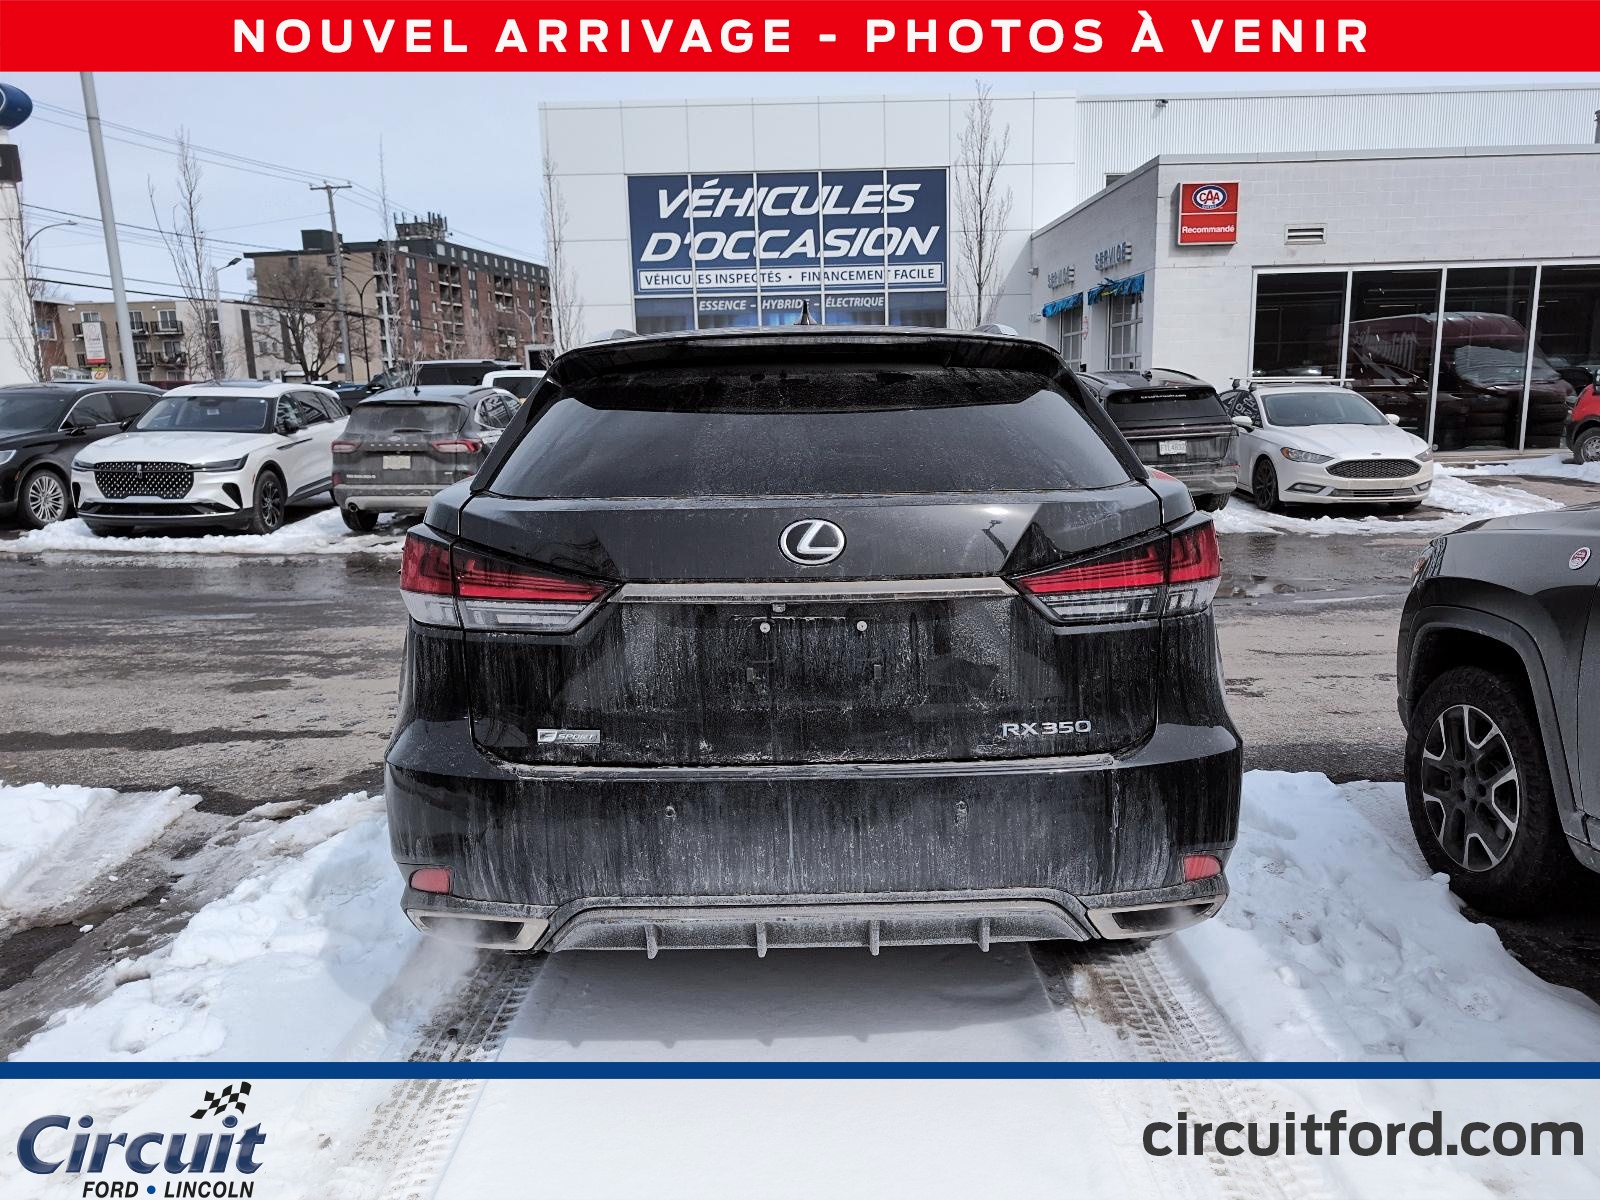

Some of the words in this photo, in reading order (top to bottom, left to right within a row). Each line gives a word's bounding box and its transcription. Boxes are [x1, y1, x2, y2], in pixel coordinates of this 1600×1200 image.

[658, 178, 921, 219] VÉHICULES
[1199, 189, 1221, 204] CAA
[1182, 224, 1235, 234] Recommandé
[640, 226, 940, 262] D'OCCASION
[894, 268, 935, 280] FACILE
[699, 300, 747, 311] ESSENCE
[826, 296, 885, 308] ÉLECTRIQUE
[1001, 722, 1039, 738] RX
[1041, 720, 1092, 735] 350
